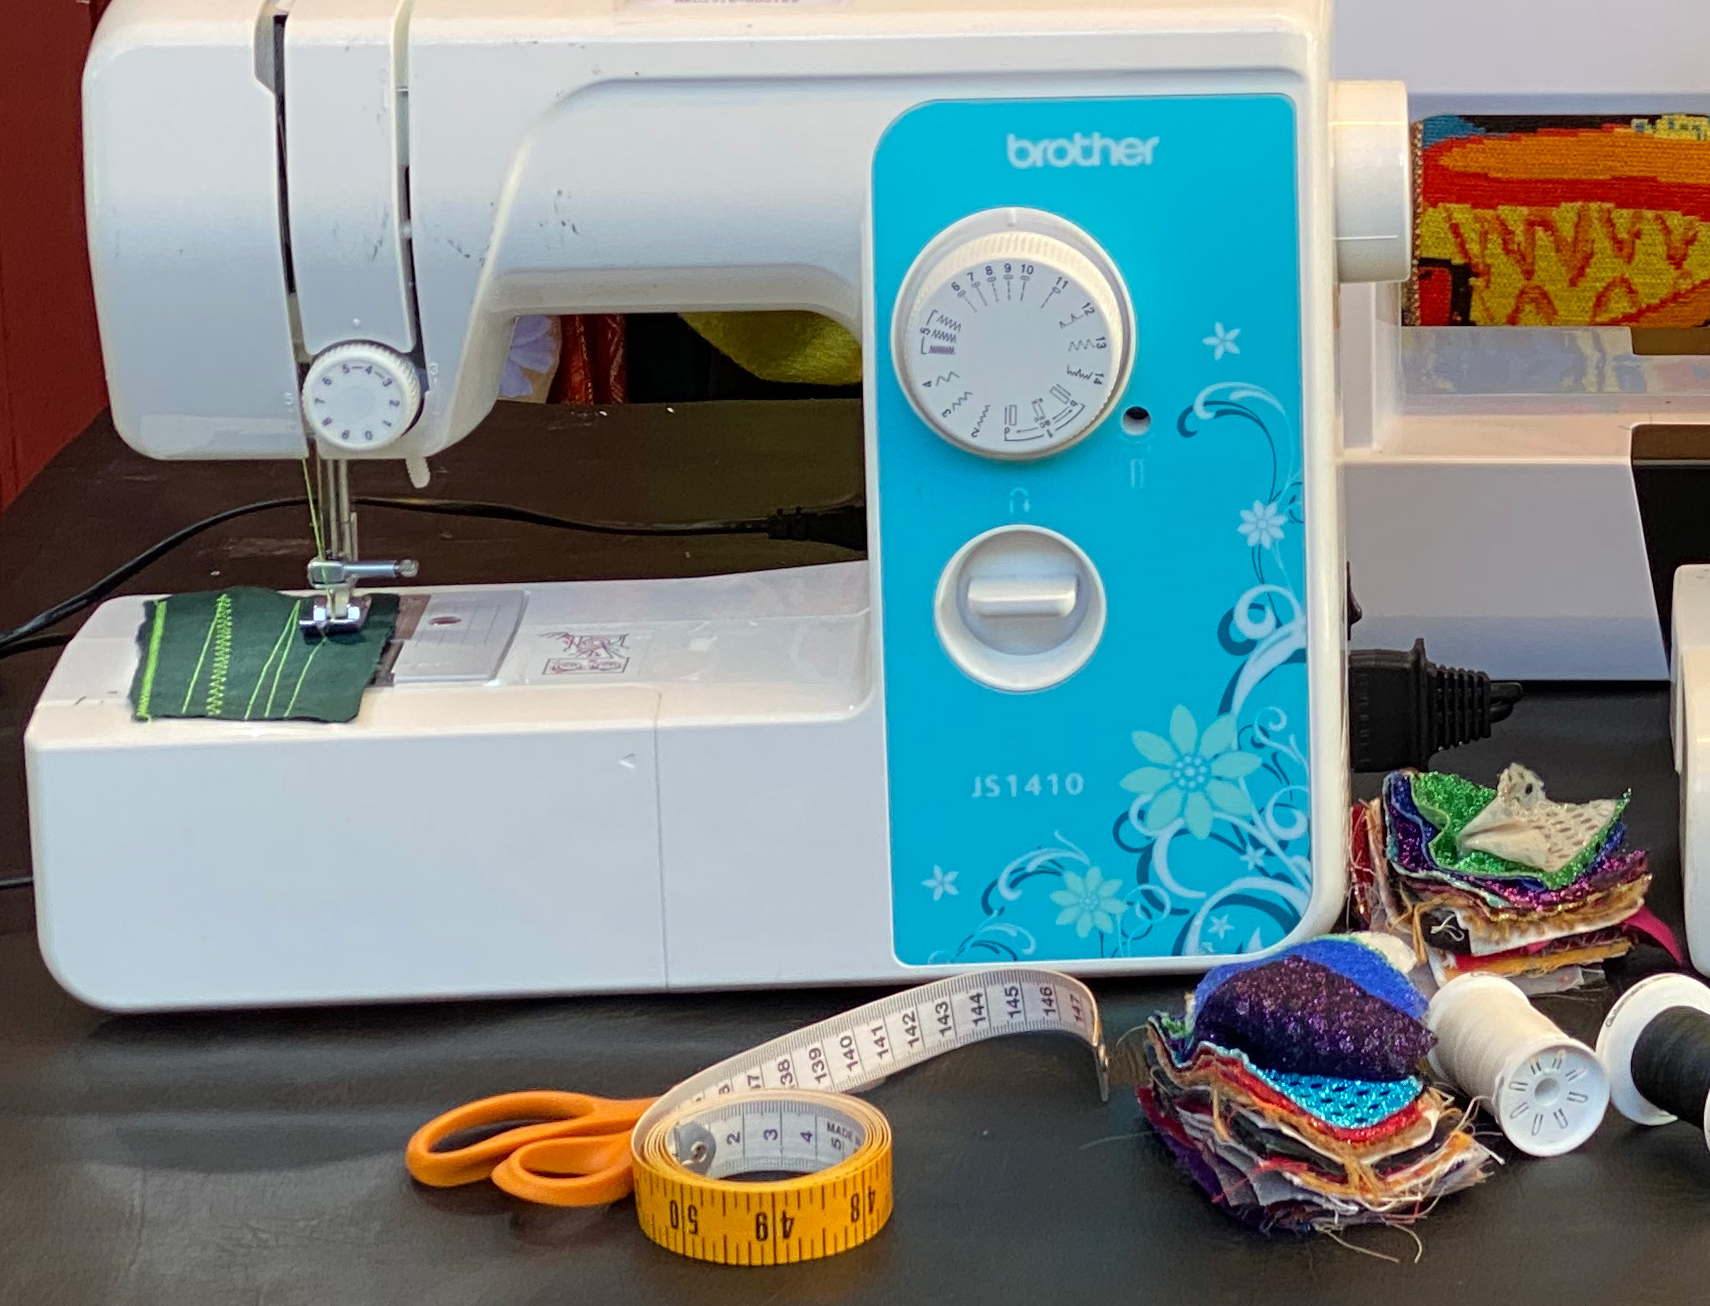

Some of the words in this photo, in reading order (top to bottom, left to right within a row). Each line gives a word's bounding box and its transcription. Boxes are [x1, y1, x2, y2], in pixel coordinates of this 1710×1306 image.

[1006, 132, 1160, 169] brother
[970, 771, 1085, 799] JS1410
[808, 1047, 828, 1084] 139
[839, 1035, 859, 1071] 140
[870, 1024, 889, 1060] 141
[902, 1010, 921, 1049] 142
[935, 1001, 952, 1038] 143
[969, 992, 986, 1027] 144
[1004, 985, 1022, 1019] 145
[1041, 986, 1056, 1017] 146
[726, 1130, 741, 1145] 2
[763, 1128, 779, 1141] 3
[799, 1130, 814, 1143] 4
[830, 1137, 843, 1151] 5
[669, 1199, 699, 1236] 50
[755, 1210, 795, 1242] 49
